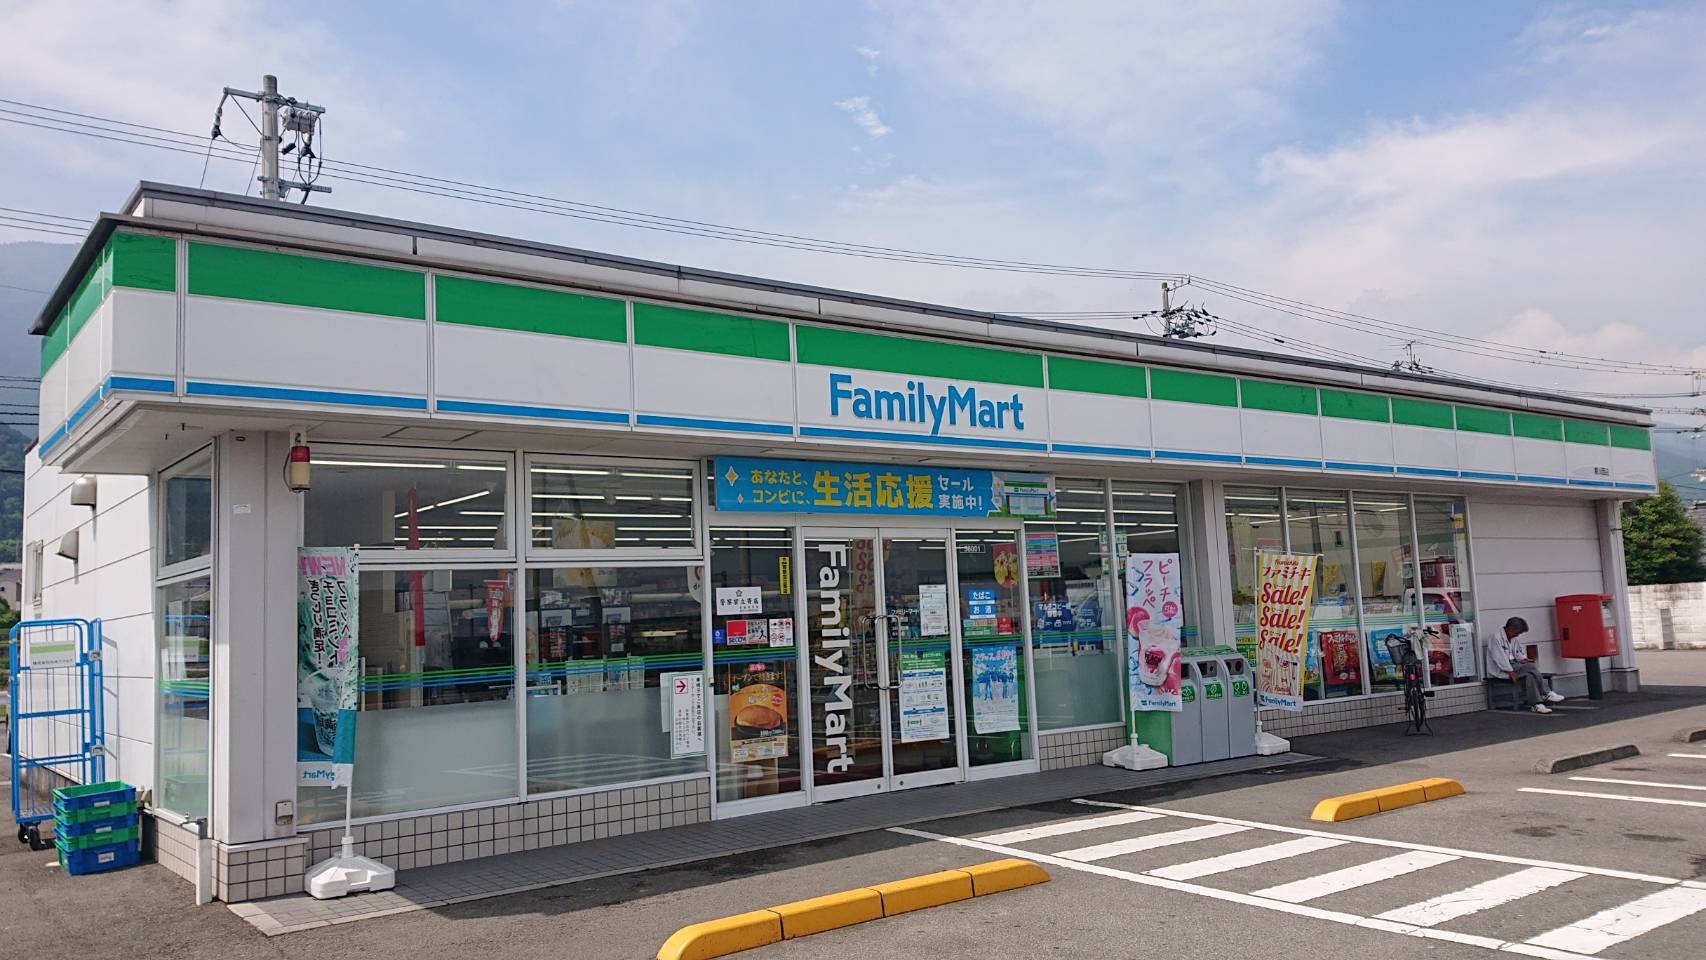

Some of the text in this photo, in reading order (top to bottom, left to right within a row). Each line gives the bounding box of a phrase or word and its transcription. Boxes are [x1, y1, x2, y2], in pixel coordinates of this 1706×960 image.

[830, 373, 1024, 436] FamilyMart
[751, 469, 808, 486] あなたと、
[938, 475, 974, 492] セール
[752, 489, 811, 505] コンビに、
[813, 470, 933, 510] 生活応援
[938, 493, 984, 511] 実施中!
[1142, 560, 1156, 608] フラッペ
[1159, 559, 1173, 602] ピーチ
[1262, 566, 1312, 580] ファミチキ
[972, 591, 991, 599] たばこ
[1261, 582, 1309, 606] Sale!
[1260, 606, 1306, 630] Sale!
[1259, 629, 1303, 654] Sale!
[815, 544, 855, 774] FamilyMart
[1264, 695, 1297, 707] FamilyMart
